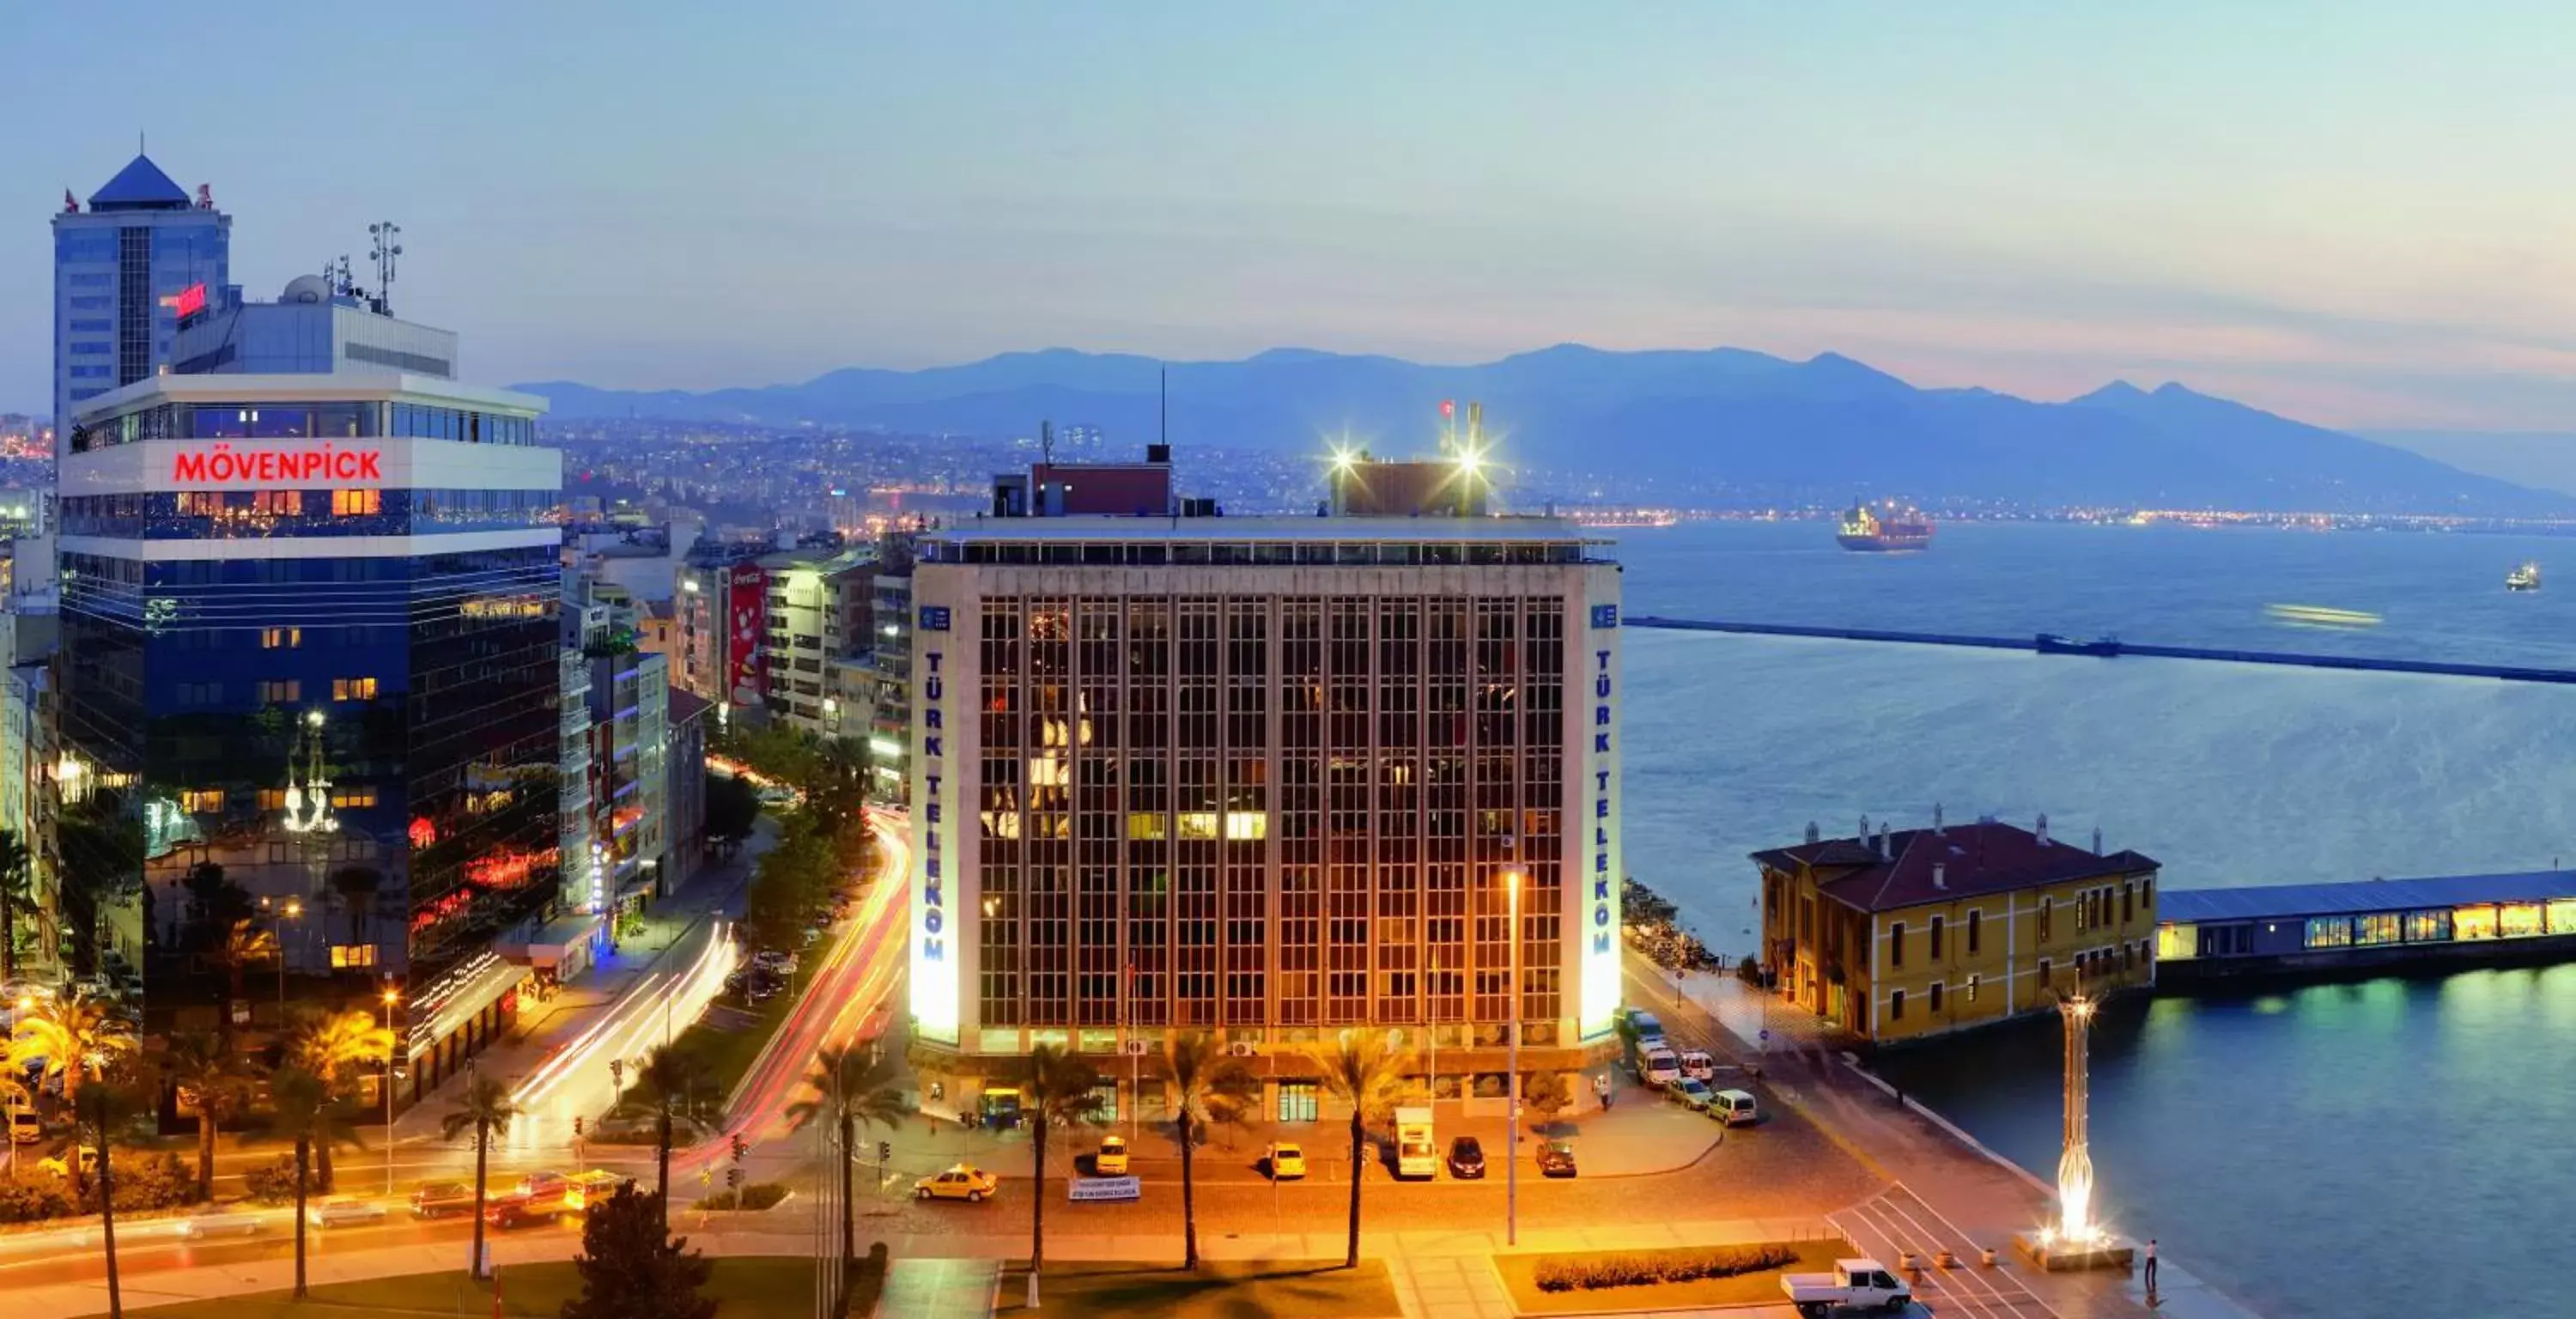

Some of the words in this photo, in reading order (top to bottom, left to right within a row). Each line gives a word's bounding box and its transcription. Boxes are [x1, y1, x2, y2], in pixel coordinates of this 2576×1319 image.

[925, 653, 943, 756] TÜRK
[1595, 650, 1611, 753] TÜRK
[924, 776, 943, 960] TELEKOM
[1594, 770, 1610, 955] TELEKOM
